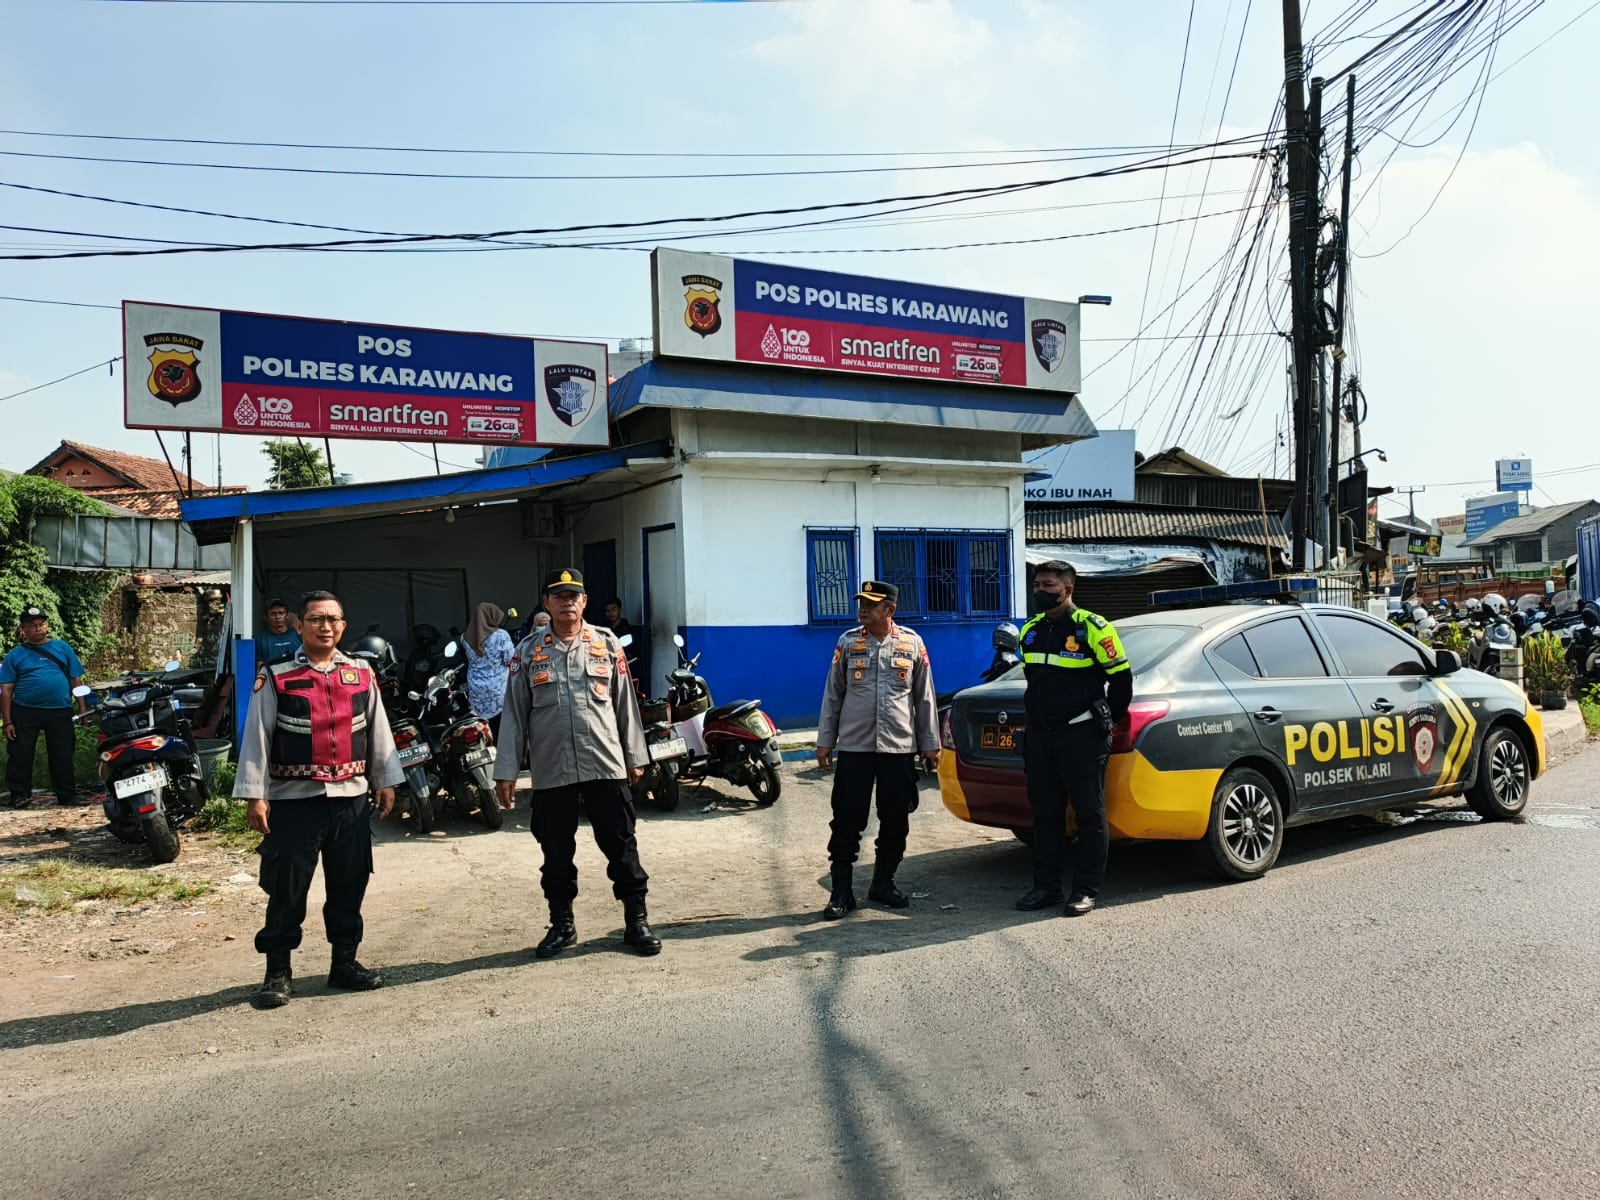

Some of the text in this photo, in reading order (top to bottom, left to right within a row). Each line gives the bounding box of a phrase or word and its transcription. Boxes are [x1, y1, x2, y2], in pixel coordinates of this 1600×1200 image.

[756, 280, 1008, 328] POS POLRES KARAWANG
[148, 336, 199, 347] JAWA BARAT
[357, 335, 411, 357] POS
[784, 345, 809, 354] UNTUK
[784, 353, 825, 363] INDONESIA
[841, 337, 940, 363] smartfren
[243, 355, 513, 392] POLRES KARAWANG
[568, 368, 592, 377] LINTAS
[841, 358, 940, 374] SINYAL KUAT INTERNET CEPAT
[261, 412, 292, 421] UNTUK
[330, 404, 448, 426] smartfren
[261, 420, 311, 429] INDONESIA
[330, 424, 448, 436] SINYAL KUAT INTERNET CEPAT
[1051, 488, 1074, 498] IBU
[1079, 488, 1112, 498] INAH
[1177, 720, 1232, 737] Contact Center 110
[1284, 715, 1406, 766] POLISI
[1305, 762, 1391, 788] POLSEK KLARI
